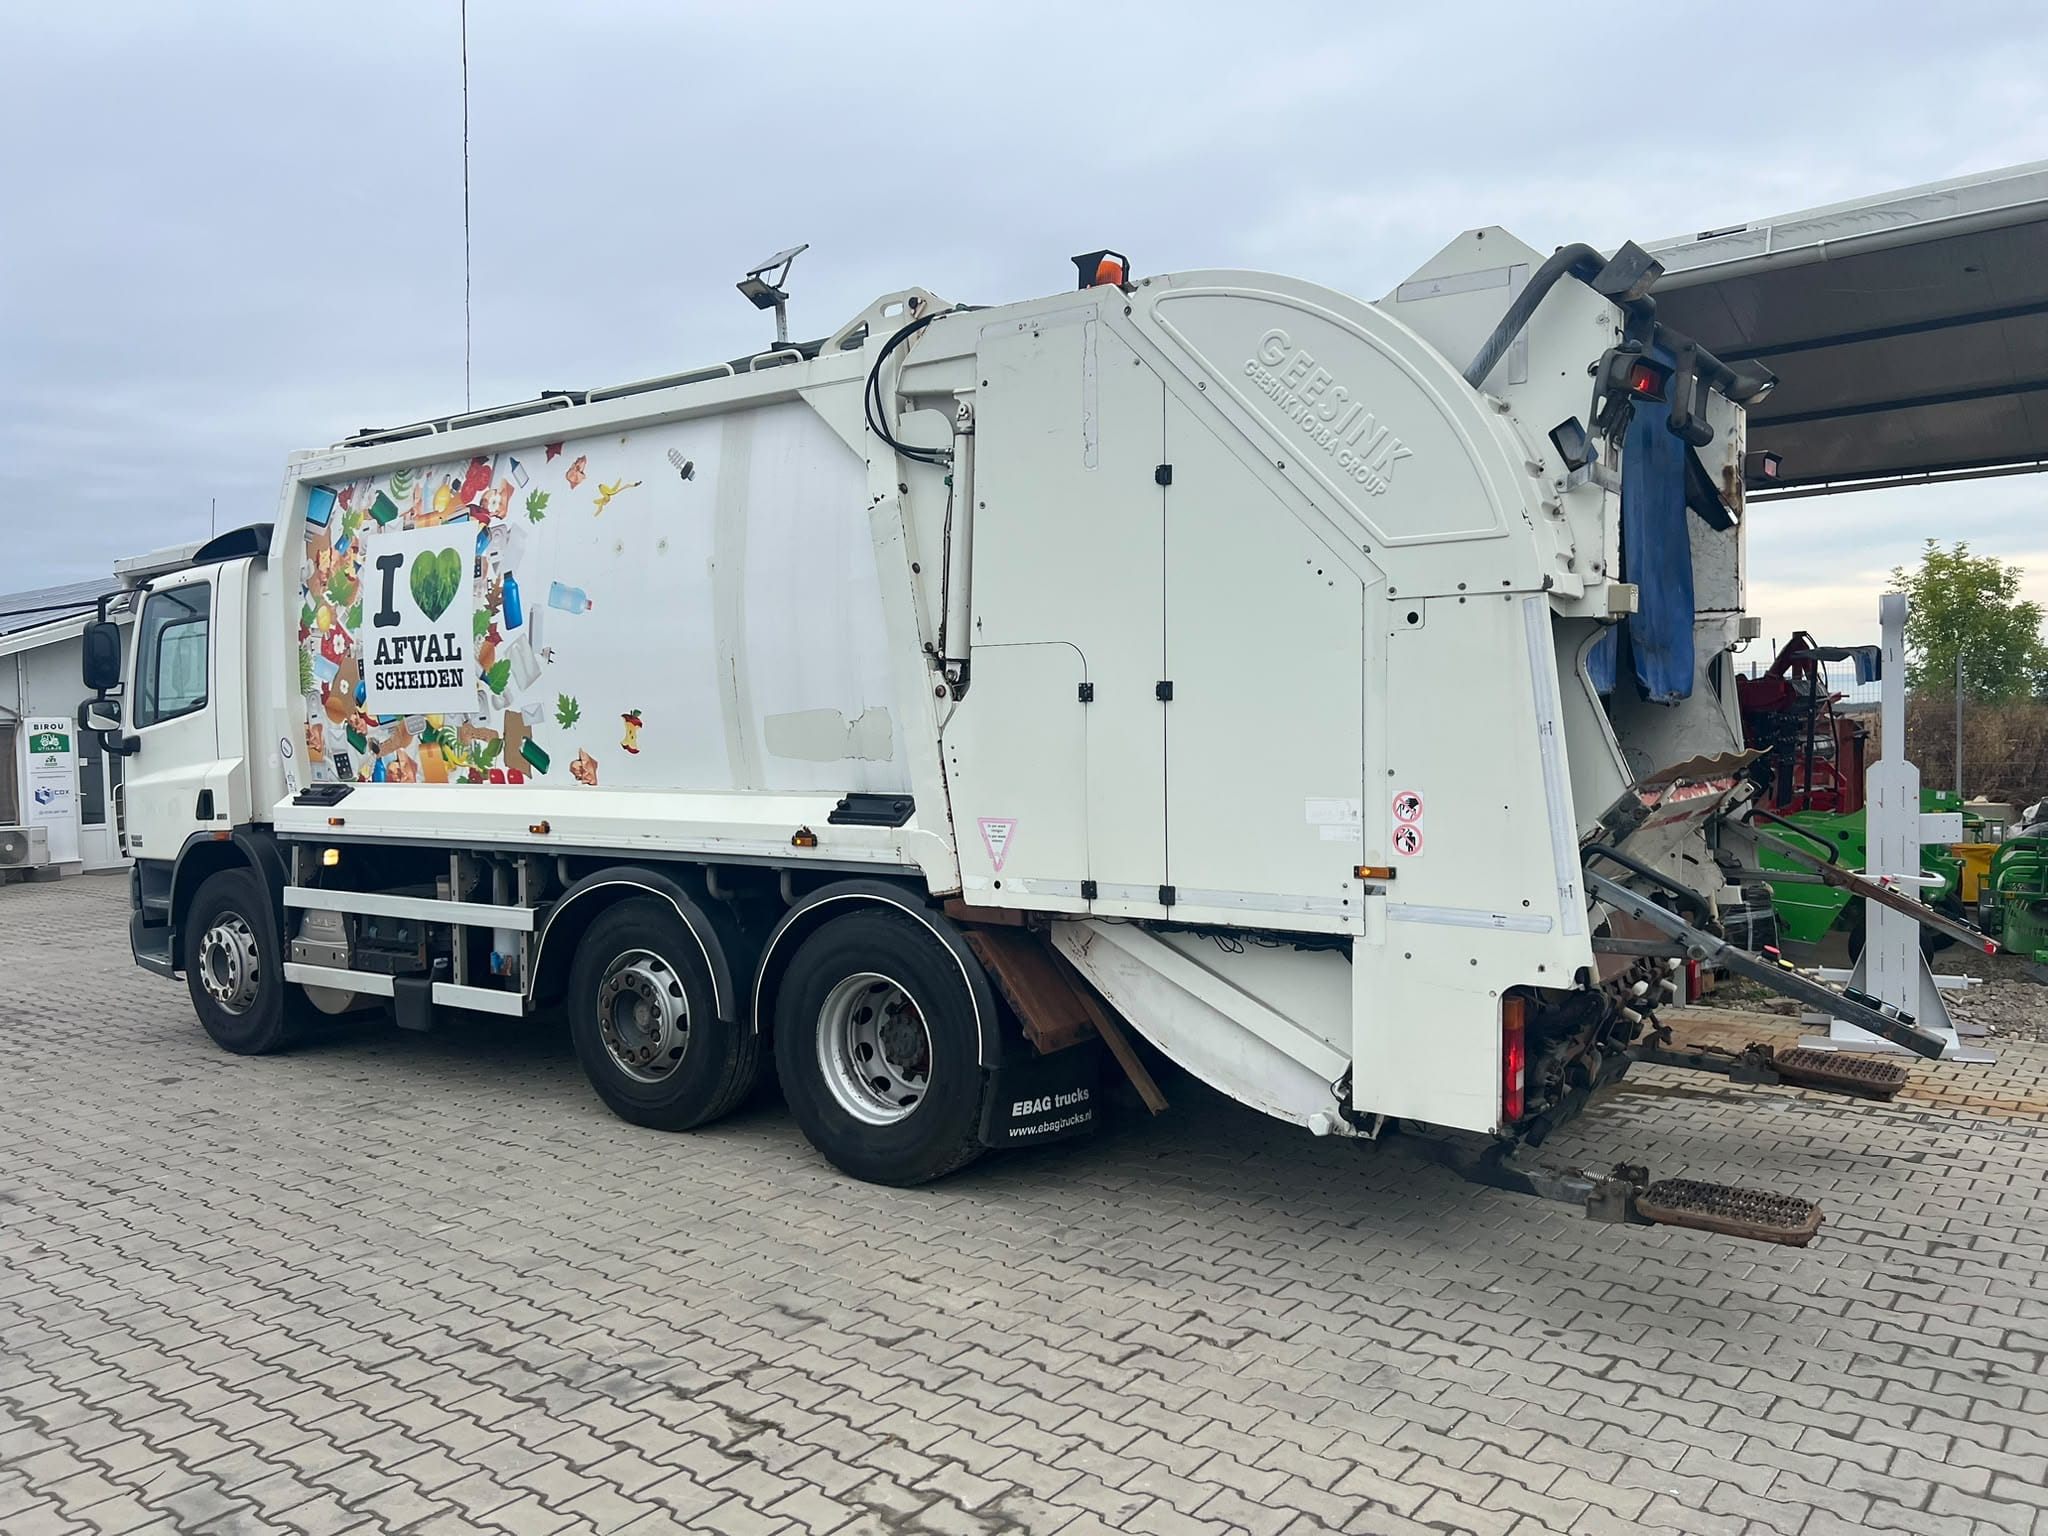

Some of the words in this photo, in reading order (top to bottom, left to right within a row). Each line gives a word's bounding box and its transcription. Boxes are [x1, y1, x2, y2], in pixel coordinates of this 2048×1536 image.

[1257, 328, 1413, 483] GEESINK
[1243, 358, 1297, 414] GEESINK
[1291, 404, 1340, 456] NORBA
[1337, 449, 1387, 496] GROUP
[373, 553, 404, 628] I
[373, 633, 462, 666] AFVAL
[375, 668, 464, 691] SCHEIDEN
[1012, 1096, 1052, 1117] EBAG
[1055, 1087, 1090, 1108] trucks
[1008, 1109, 1092, 1137] www.ebagtrucks.nl
